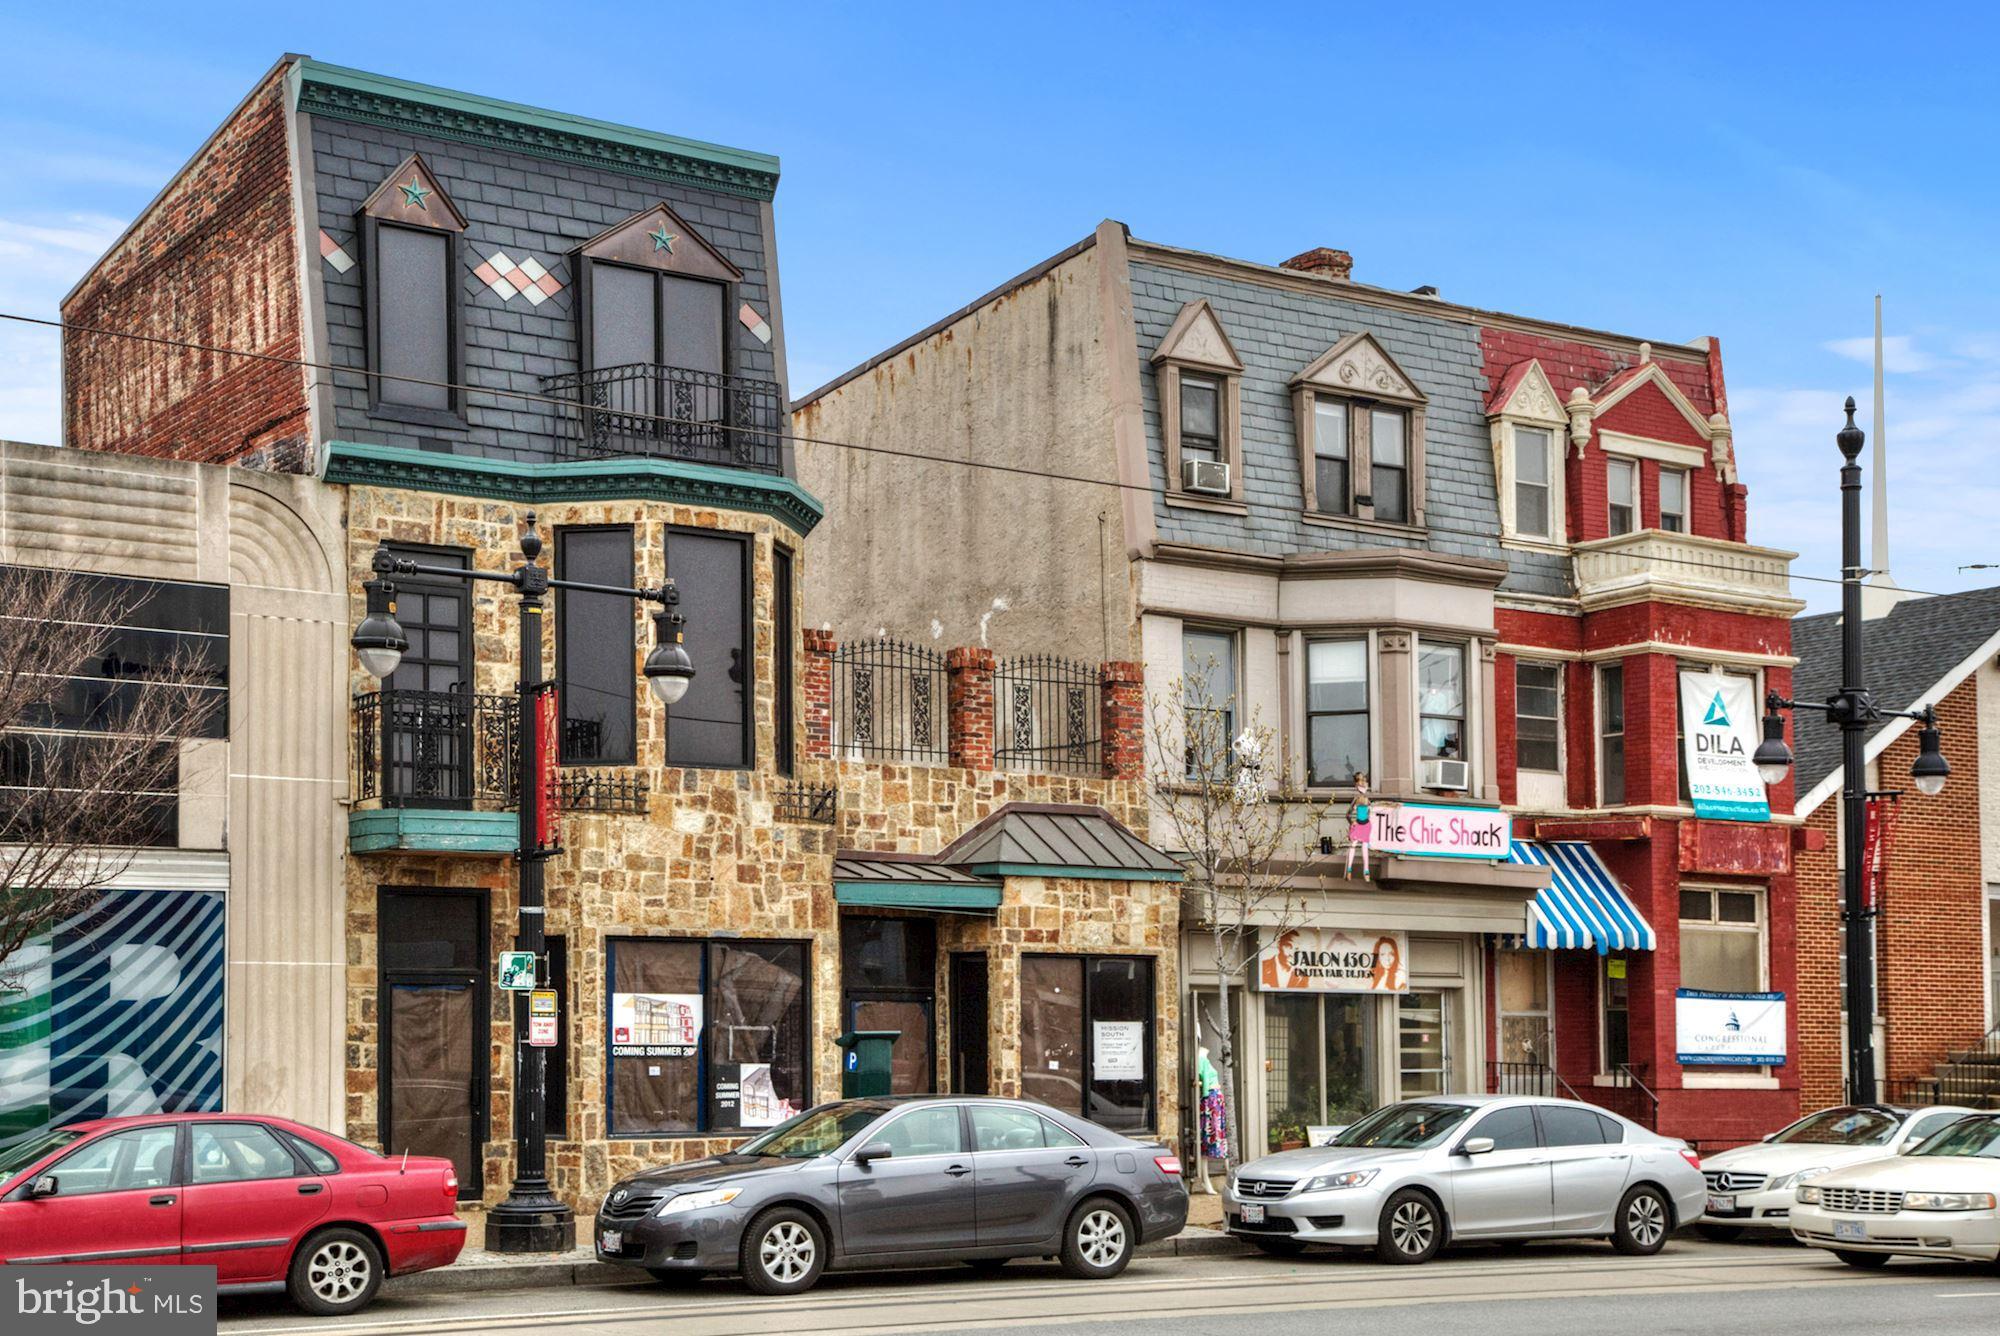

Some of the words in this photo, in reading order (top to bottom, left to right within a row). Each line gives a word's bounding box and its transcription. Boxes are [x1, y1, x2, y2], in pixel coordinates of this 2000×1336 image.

[1696, 733, 1745, 755] DILA
[1697, 757, 1746, 767] DEVELOPMENT
[1375, 812, 1406, 842] The
[1409, 815, 1442, 845] Chic
[1449, 817, 1502, 847] Shack
[1290, 950, 1343, 968] SALON
[1295, 968, 1324, 977] UNISEX
[1325, 968, 1343, 978] HAIR
[1345, 969, 1375, 979] DESIGN
[613, 1046, 645, 1056] COMING
[646, 1046, 682, 1056] SUMMER
[849, 1052, 857, 1070] P
[715, 1091, 740, 1099] SUMMER
[720, 1100, 735, 1108] 2012
